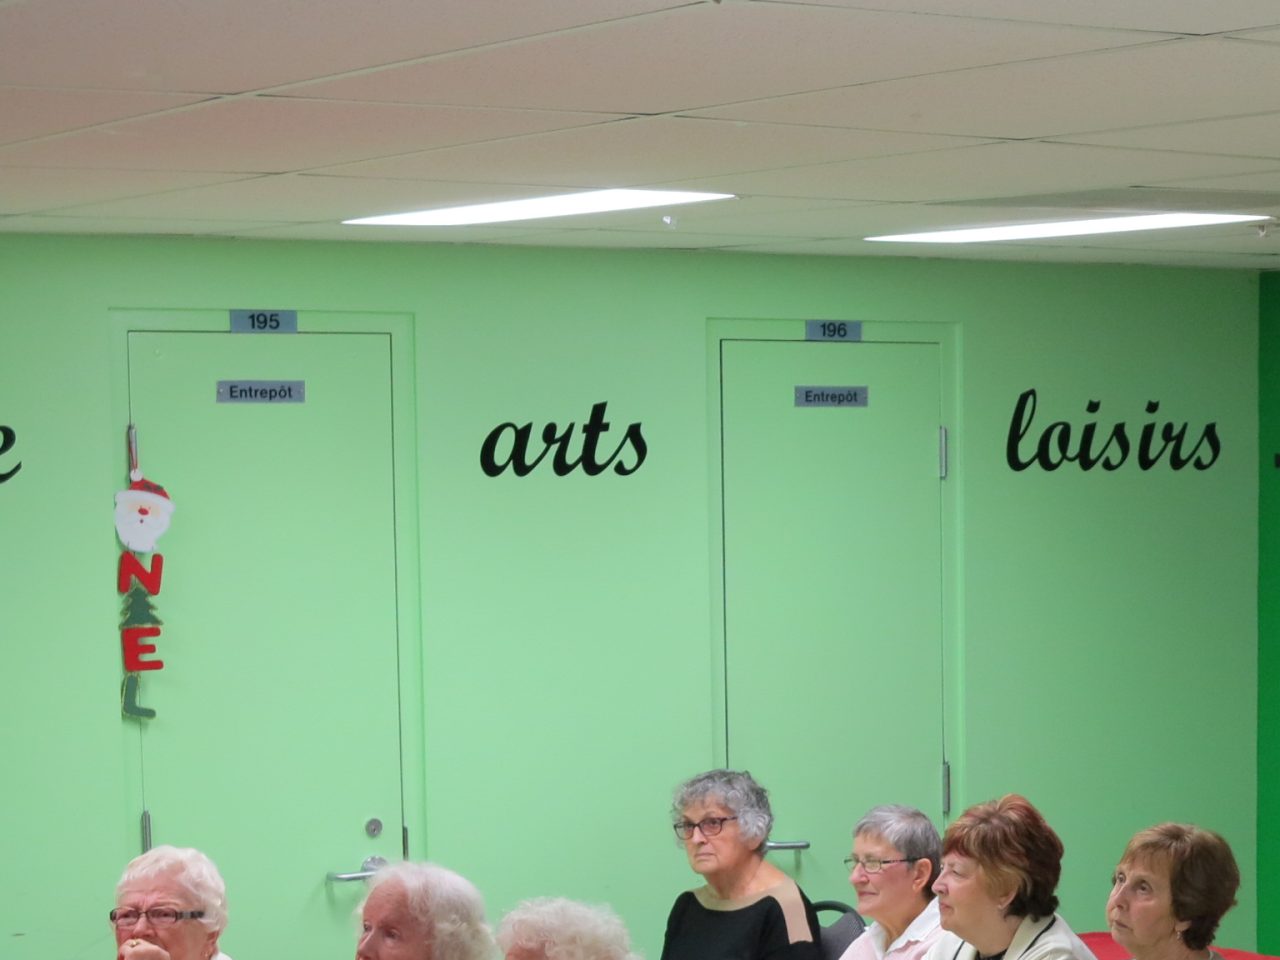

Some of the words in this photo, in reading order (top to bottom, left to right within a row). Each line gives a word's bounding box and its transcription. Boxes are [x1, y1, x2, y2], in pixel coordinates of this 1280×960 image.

[247, 313, 281, 330] 195
[819, 322, 848, 338] 196
[229, 384, 293, 401] Entrepôt
[804, 389, 859, 405] Entrepôt
[1007, 388, 1221, 472] loisirs
[480, 401, 649, 478] arts
